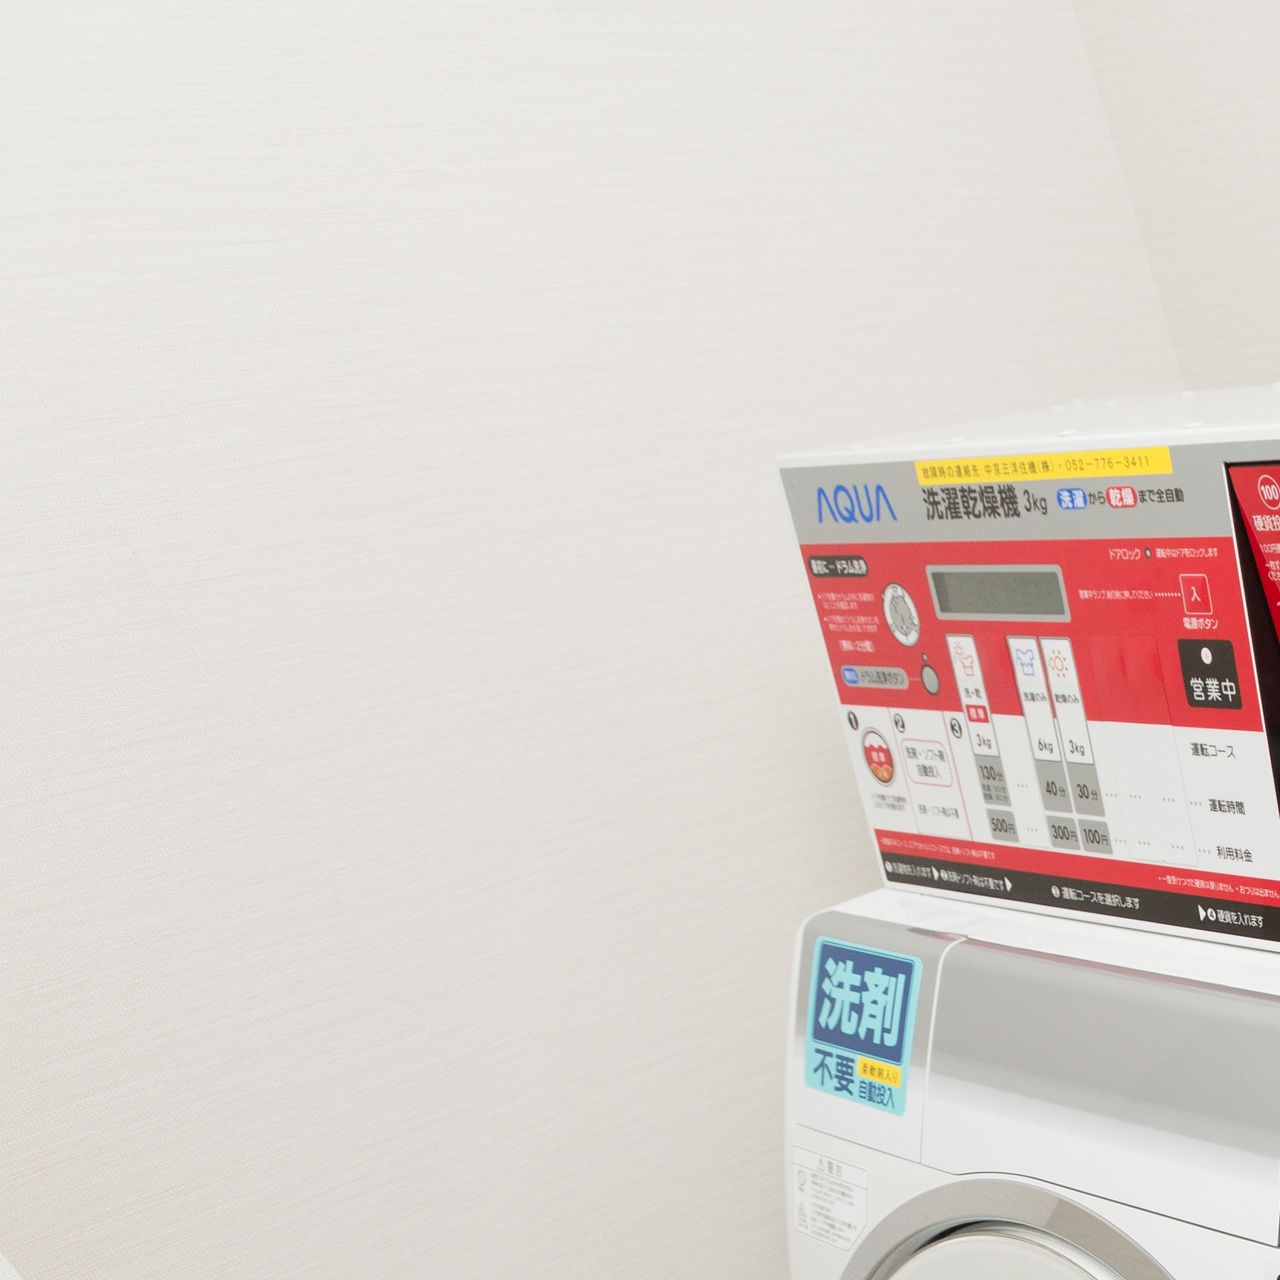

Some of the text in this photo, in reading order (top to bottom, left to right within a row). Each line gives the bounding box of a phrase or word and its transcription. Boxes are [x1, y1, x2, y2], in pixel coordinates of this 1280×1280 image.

[1261, 485, 1278, 500] 100
[816, 484, 898, 523] AQUA
[922, 485, 1020, 521] 洗濯乾燥機
[1024, 490, 1047, 515] 3kg
[1060, 489, 1085, 508] 洗濯
[1089, 492, 1105, 505] から
[1109, 488, 1135, 506] 乾燥
[1191, 587, 1201, 601] 入
[1190, 677, 1236, 702] 営業中
[977, 734, 992, 749] 3kg
[1038, 738, 1053, 753] 6kg
[1069, 740, 1085, 755] 3kg
[1190, 742, 1236, 758] 運転コース
[1208, 799, 1246, 815] 運転時間
[1217, 846, 1253, 863] 利用料金
[818, 957, 906, 1047] 洗剤
[813, 1048, 855, 1096] 不要
[858, 1079, 895, 1109] 自動投入
